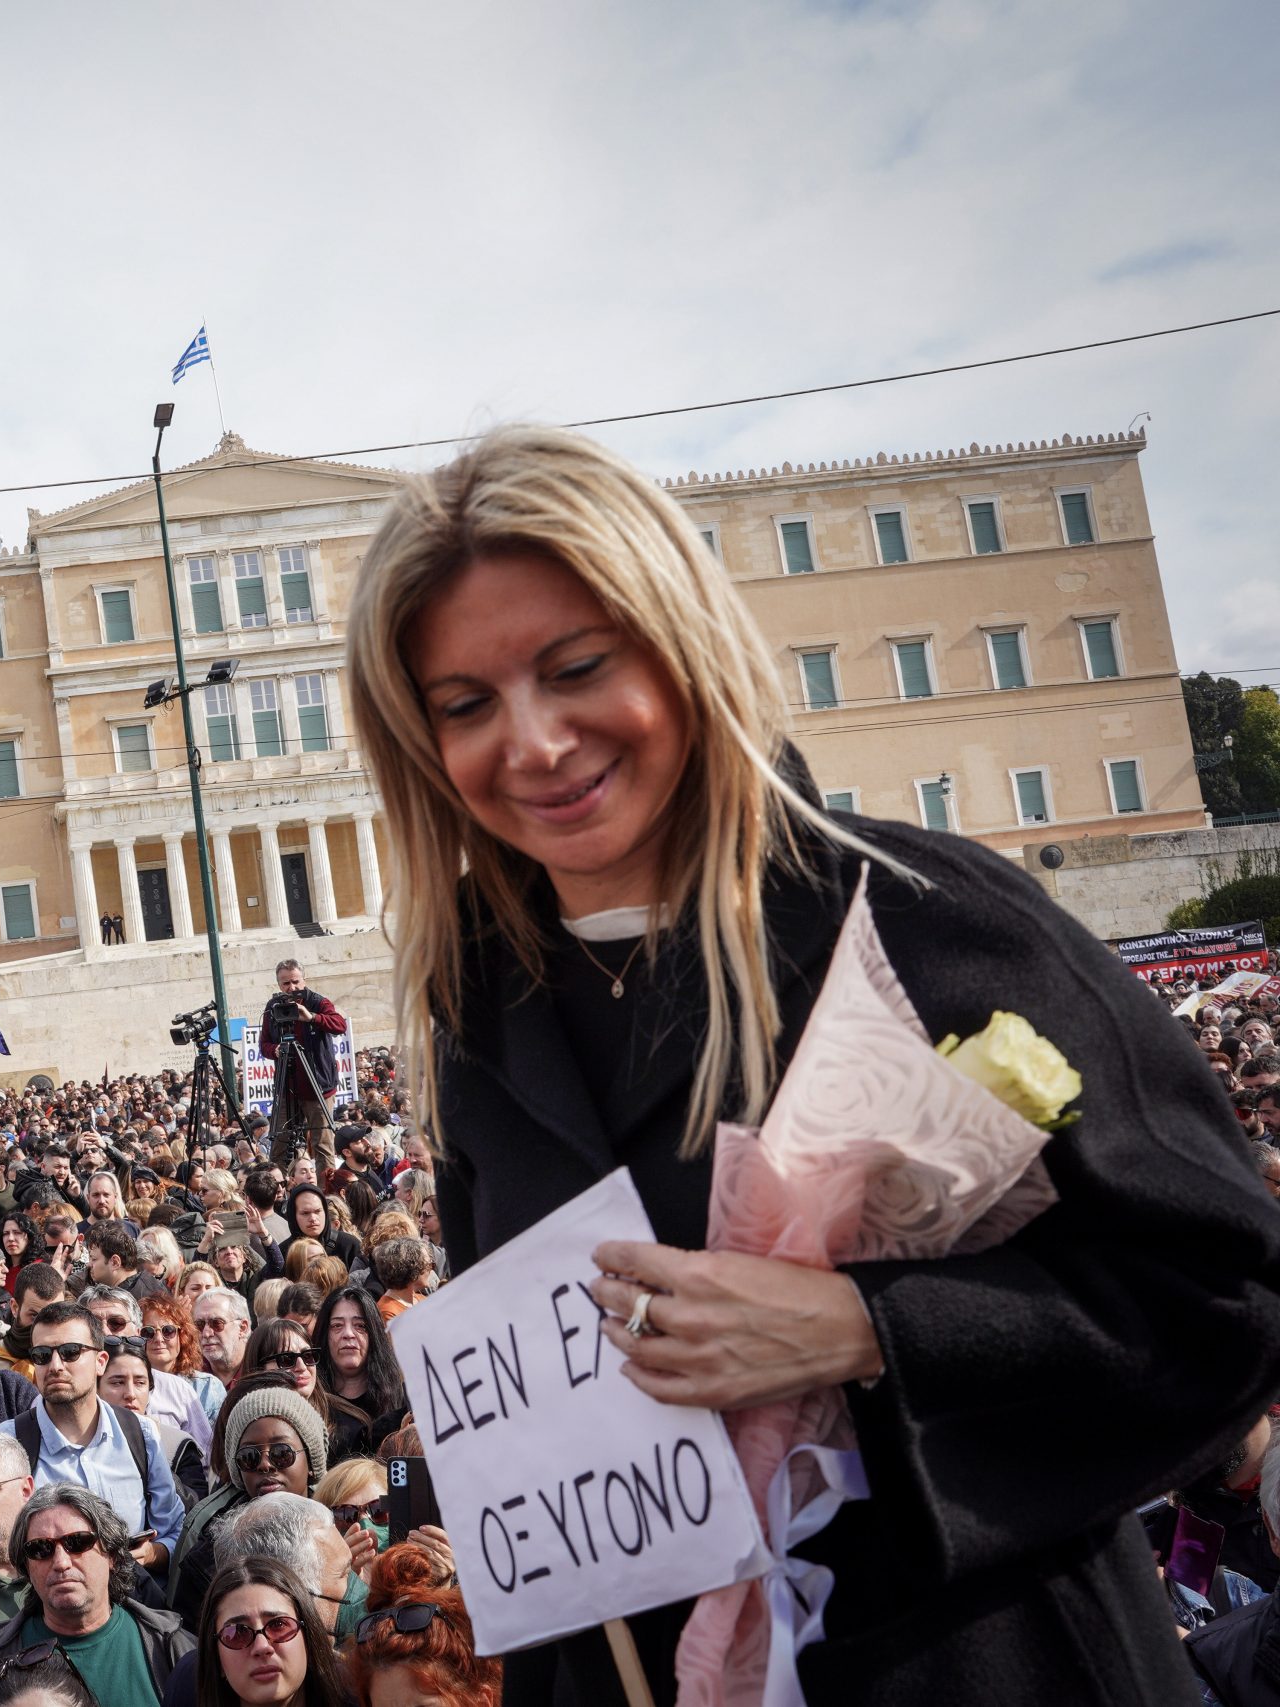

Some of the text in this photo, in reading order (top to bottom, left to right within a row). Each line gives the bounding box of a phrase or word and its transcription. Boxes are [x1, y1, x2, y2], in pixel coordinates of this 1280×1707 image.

[1118, 929, 1234, 951] ΚΩΝΣΤΑΝΤΙΝΟΣ ΤΑΣΟΥΛΑΣ
[420, 1280, 609, 1445] ΔΕΝ ΕΧ
[480, 1438, 712, 1593] ΟΞΥΓΟΝΟ
